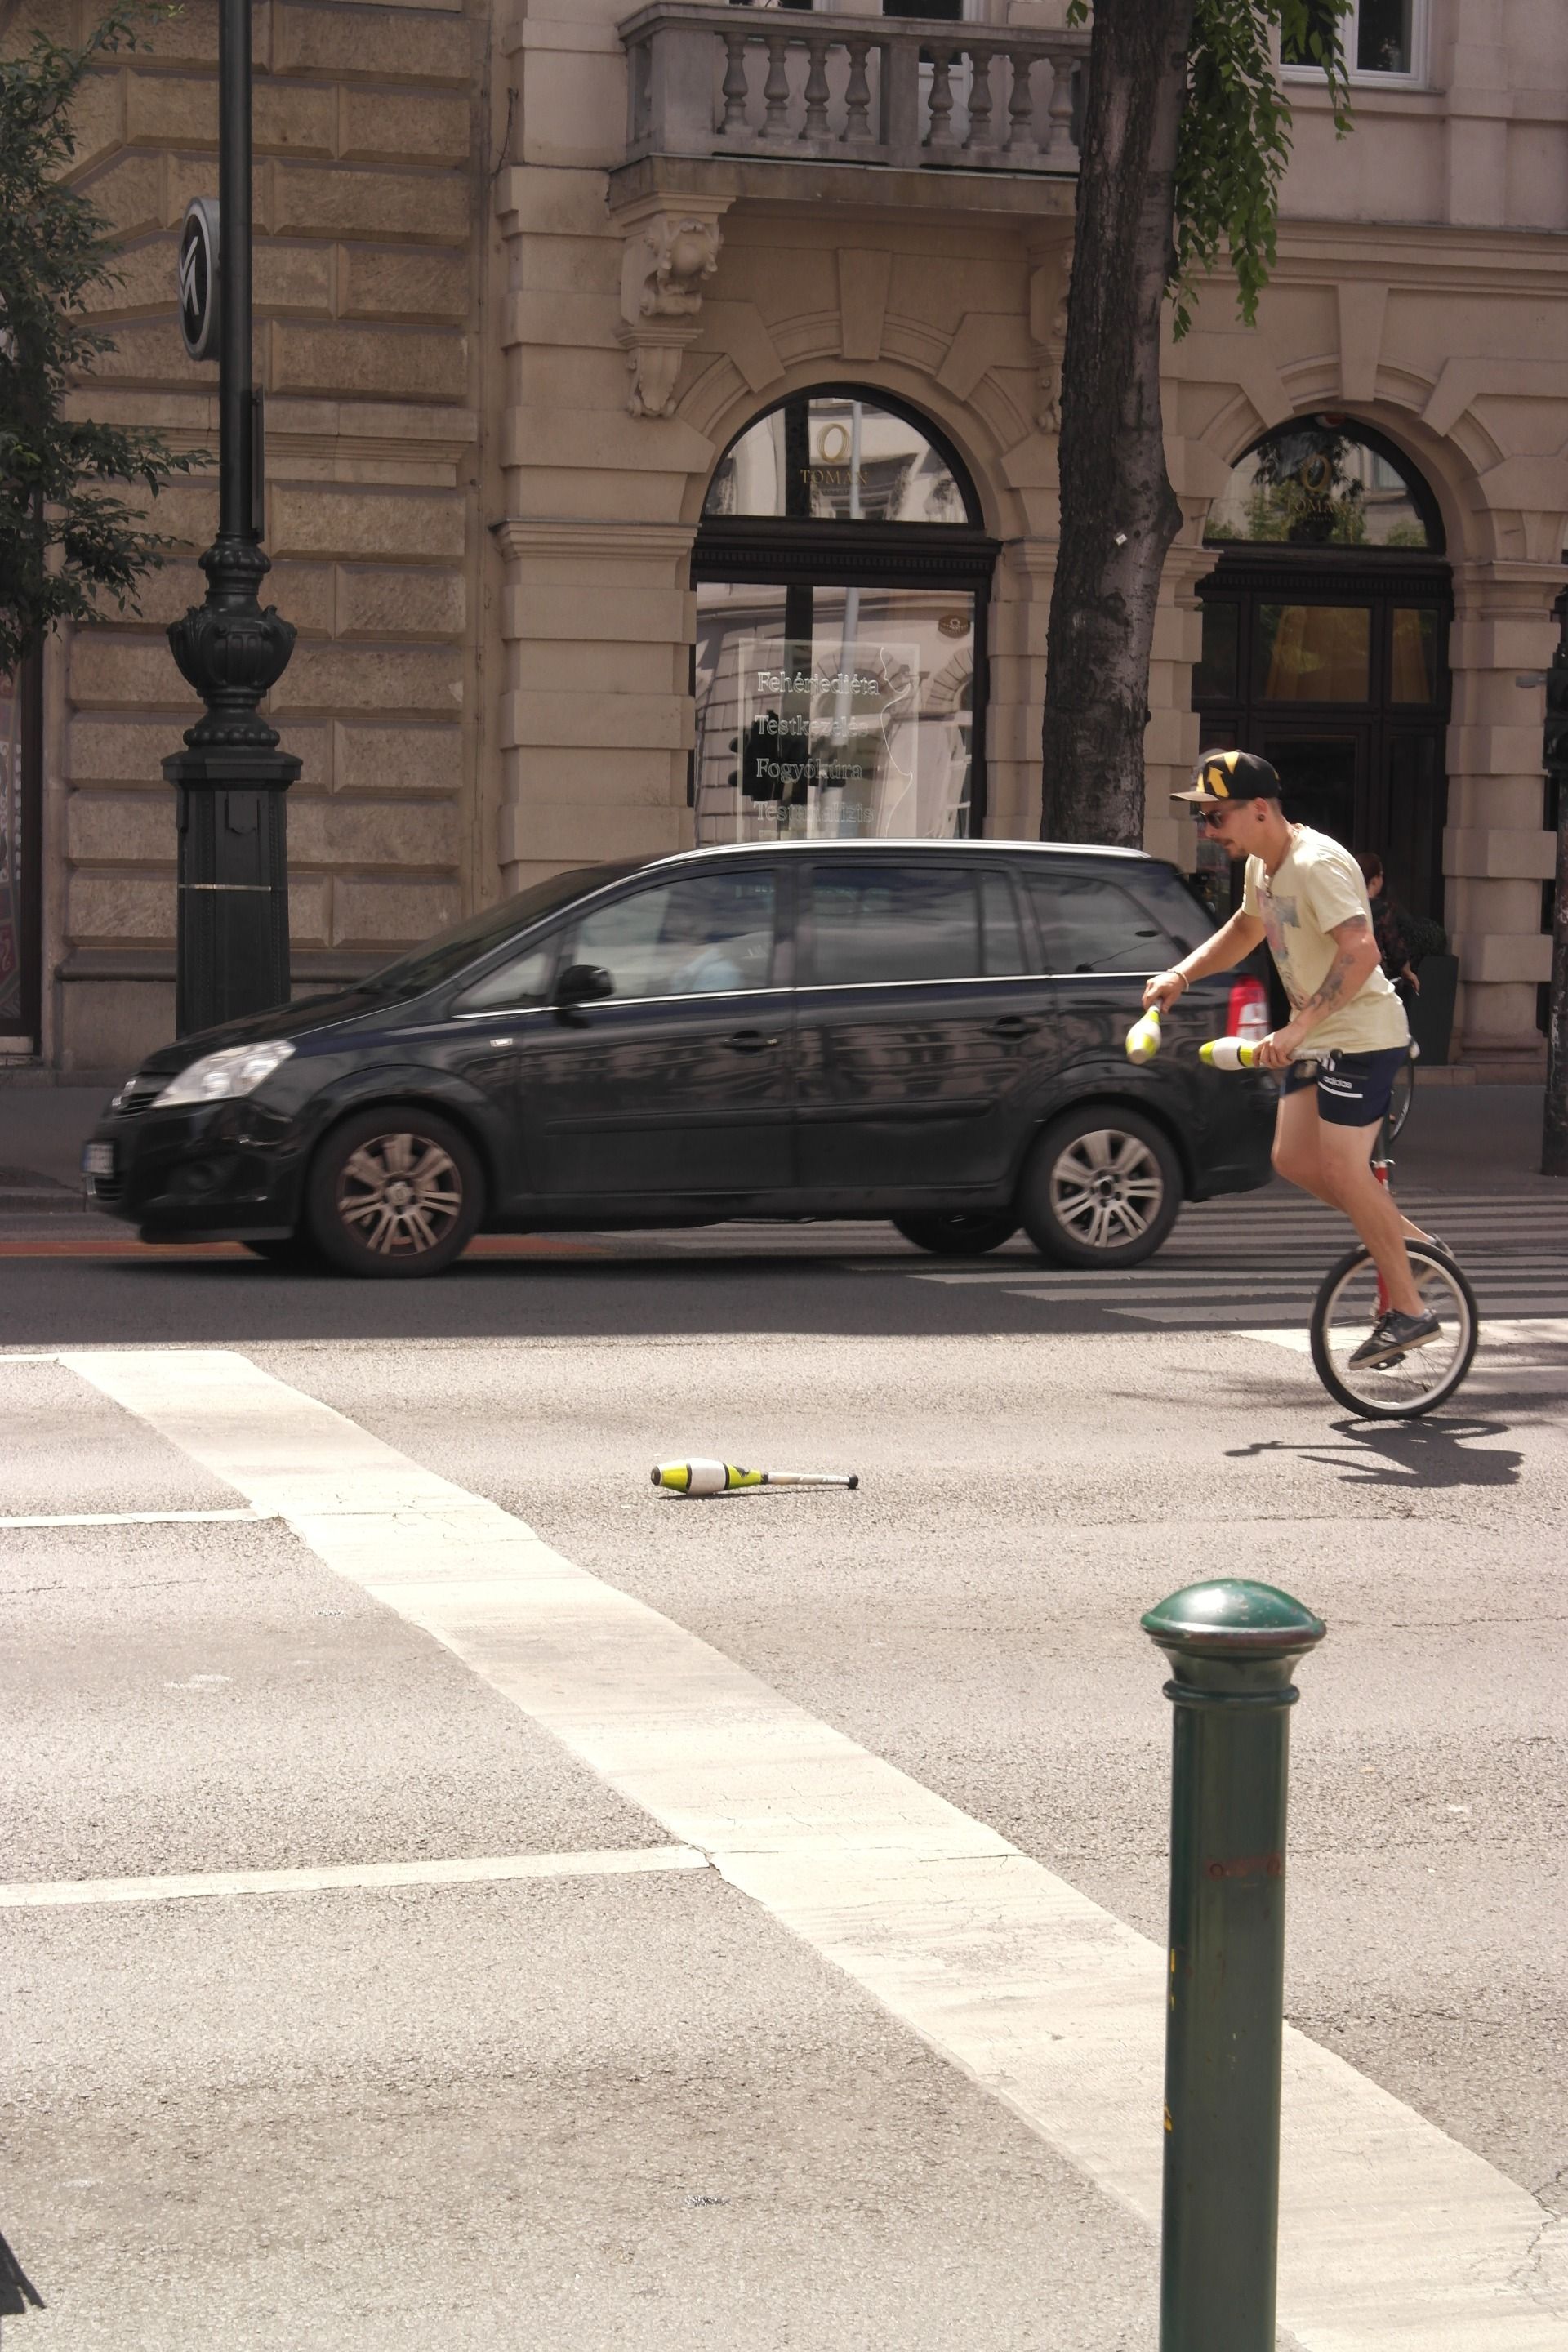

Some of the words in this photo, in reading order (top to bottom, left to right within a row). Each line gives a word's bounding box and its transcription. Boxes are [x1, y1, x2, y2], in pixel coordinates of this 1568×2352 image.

[757, 671, 880, 698] Fehérjediéta
[755, 715, 869, 737] Testkezelés
[756, 758, 862, 784] Fogyókúra
[1323, 1076, 1353, 1089] adidas
